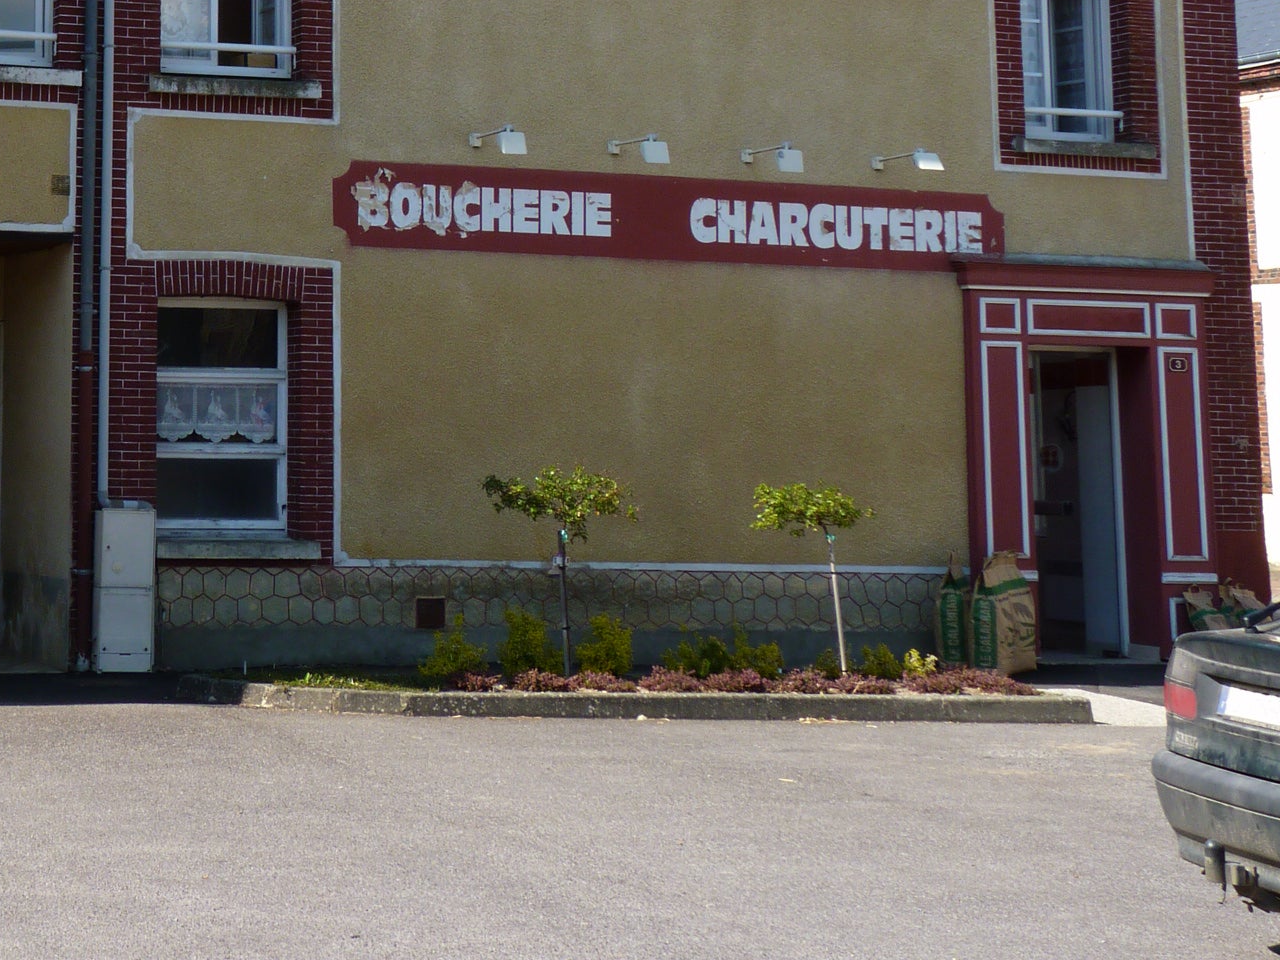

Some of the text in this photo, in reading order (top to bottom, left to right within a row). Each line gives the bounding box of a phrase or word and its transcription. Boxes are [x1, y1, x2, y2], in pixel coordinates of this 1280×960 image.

[356, 181, 983, 254] BOUCHERIE CHARCUTERIE
[1175, 360, 1182, 369] 3
